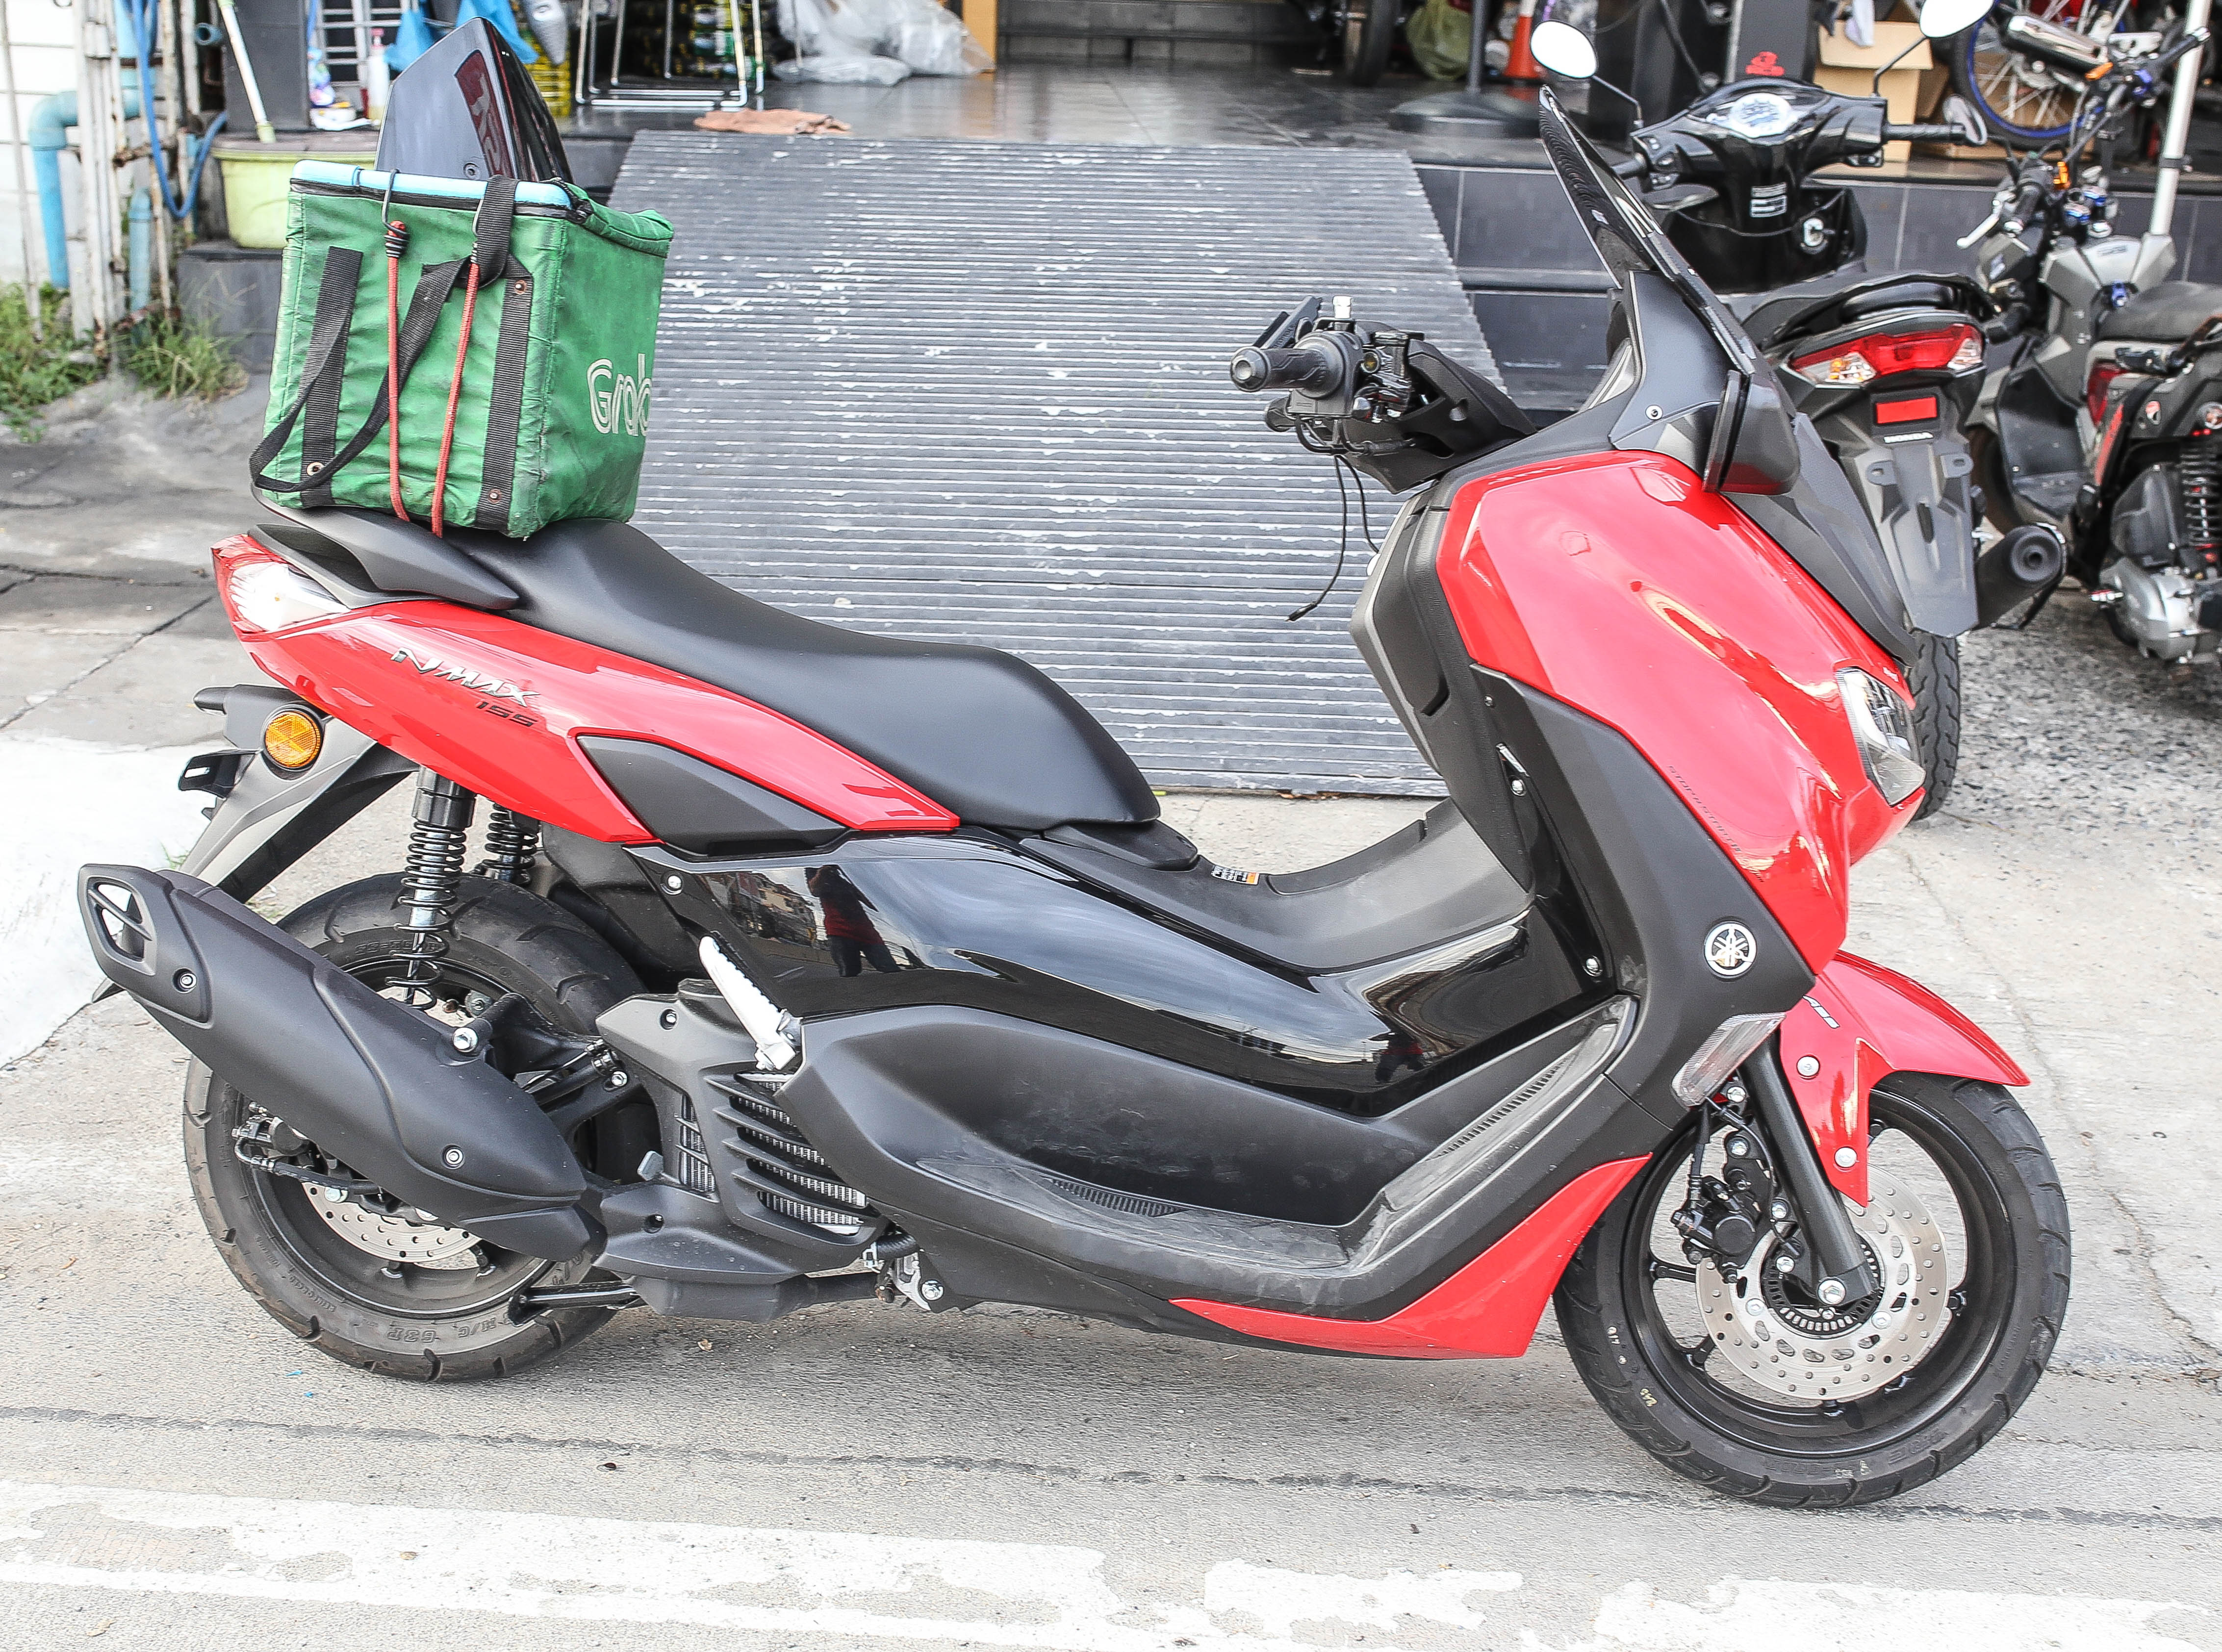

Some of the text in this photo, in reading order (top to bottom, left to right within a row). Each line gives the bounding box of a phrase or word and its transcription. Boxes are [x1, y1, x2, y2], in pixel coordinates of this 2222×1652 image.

[587, 353, 652, 436] Grab
[1884, 432, 1934, 443] HONDA
[391, 647, 540, 707] NMAX
[477, 701, 537, 727] 155
[1802, 994, 1840, 1029] ABS
